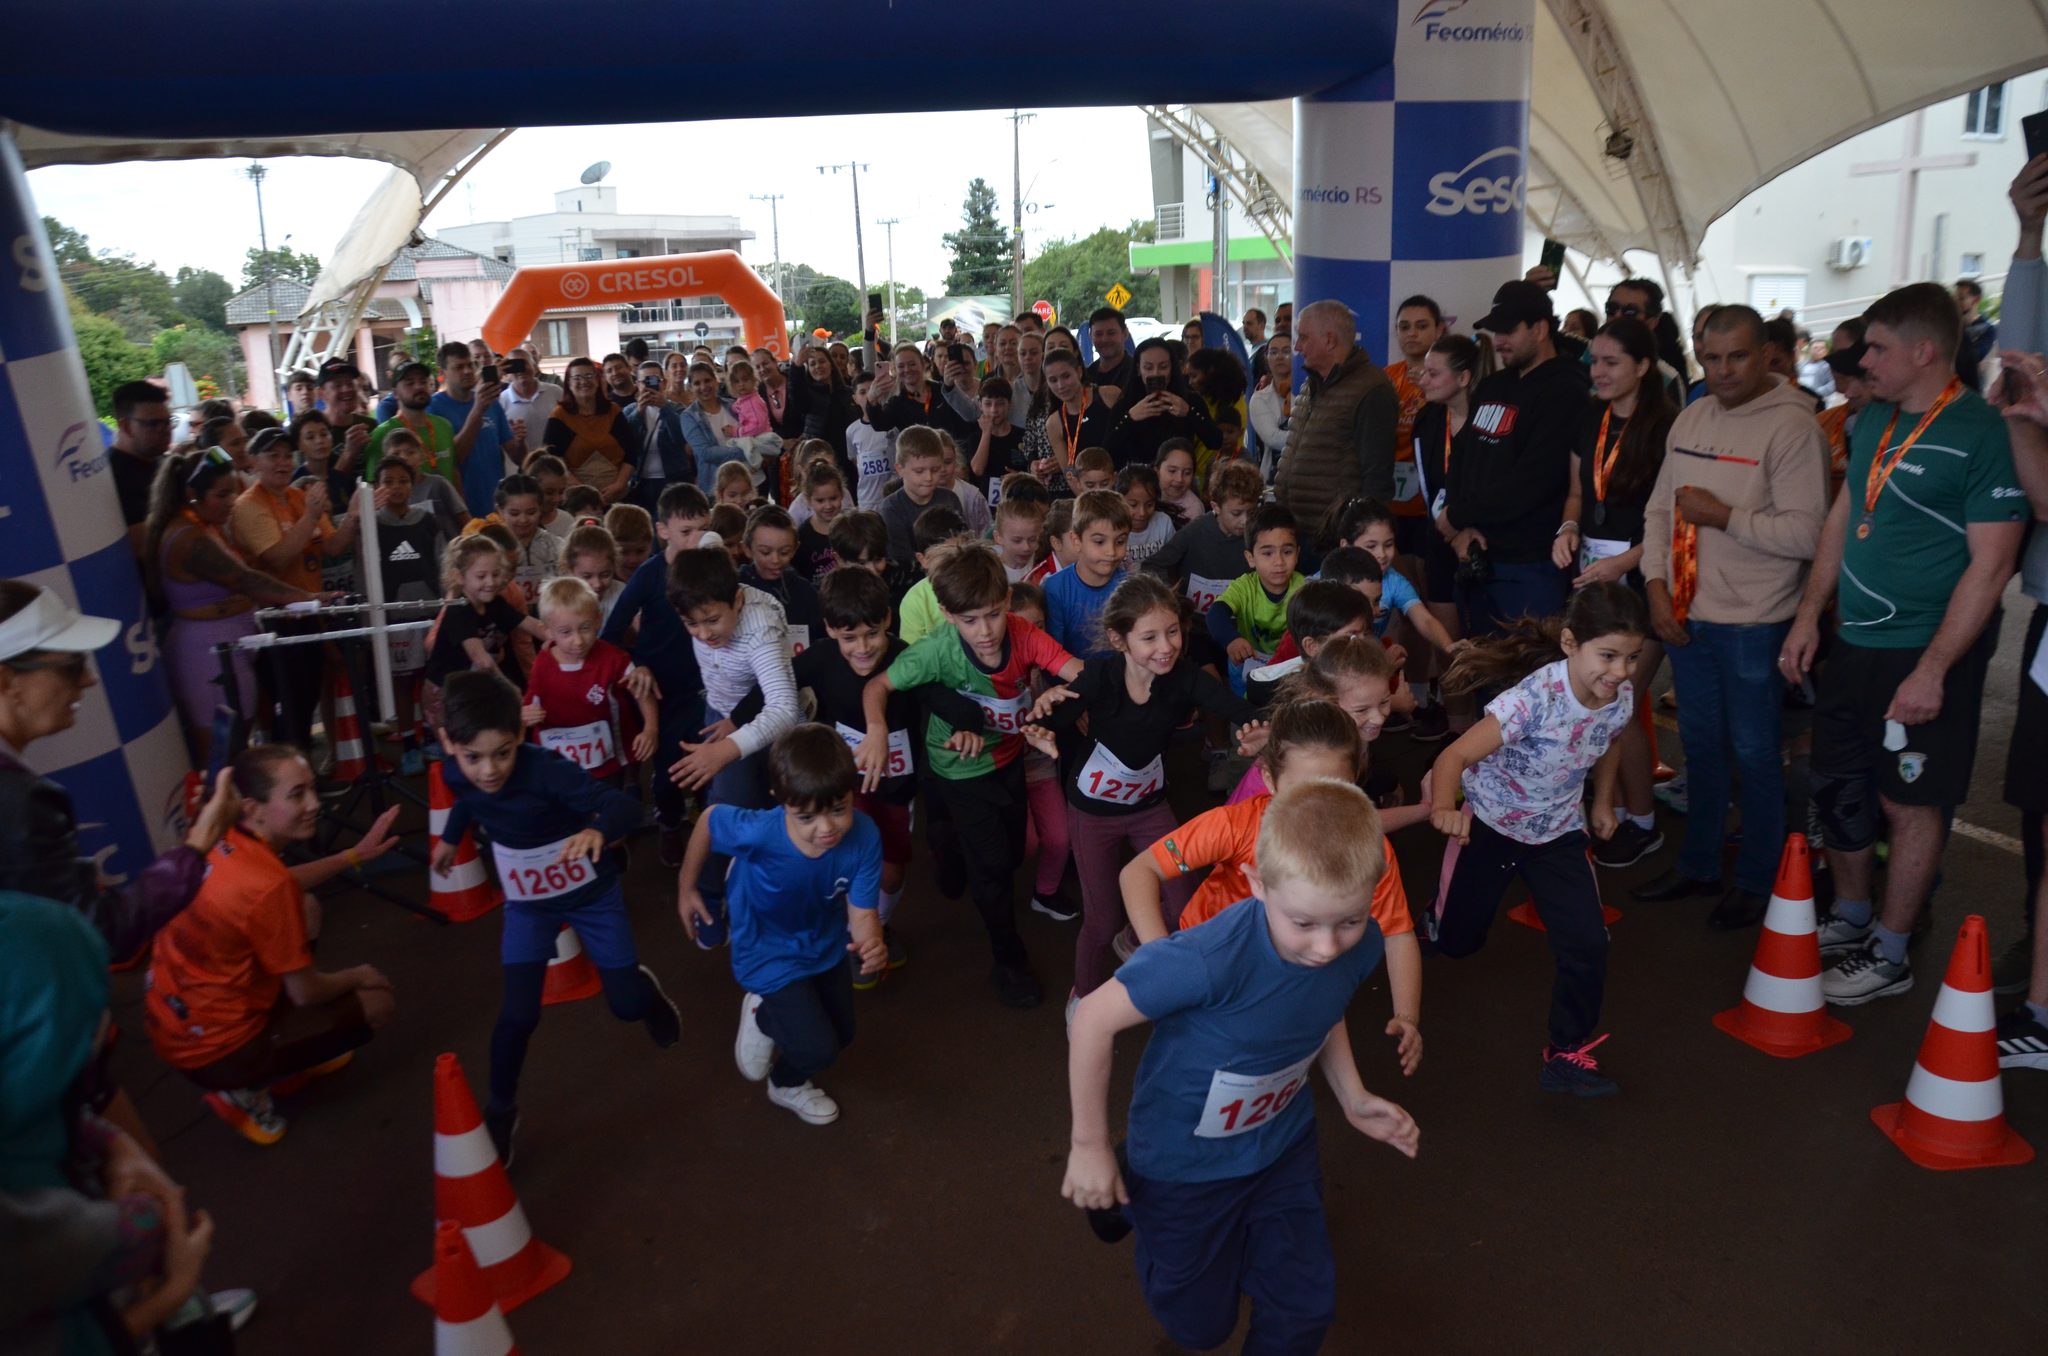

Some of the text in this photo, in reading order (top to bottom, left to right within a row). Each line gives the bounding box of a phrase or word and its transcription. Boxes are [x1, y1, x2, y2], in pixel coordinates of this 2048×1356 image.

[1355, 186, 1382, 204] RS
[598, 266, 703, 293] CRESOL
[863, 458, 891, 476] 2582
[1089, 770, 1158, 800] 1274
[509, 857, 586, 896] 1266
